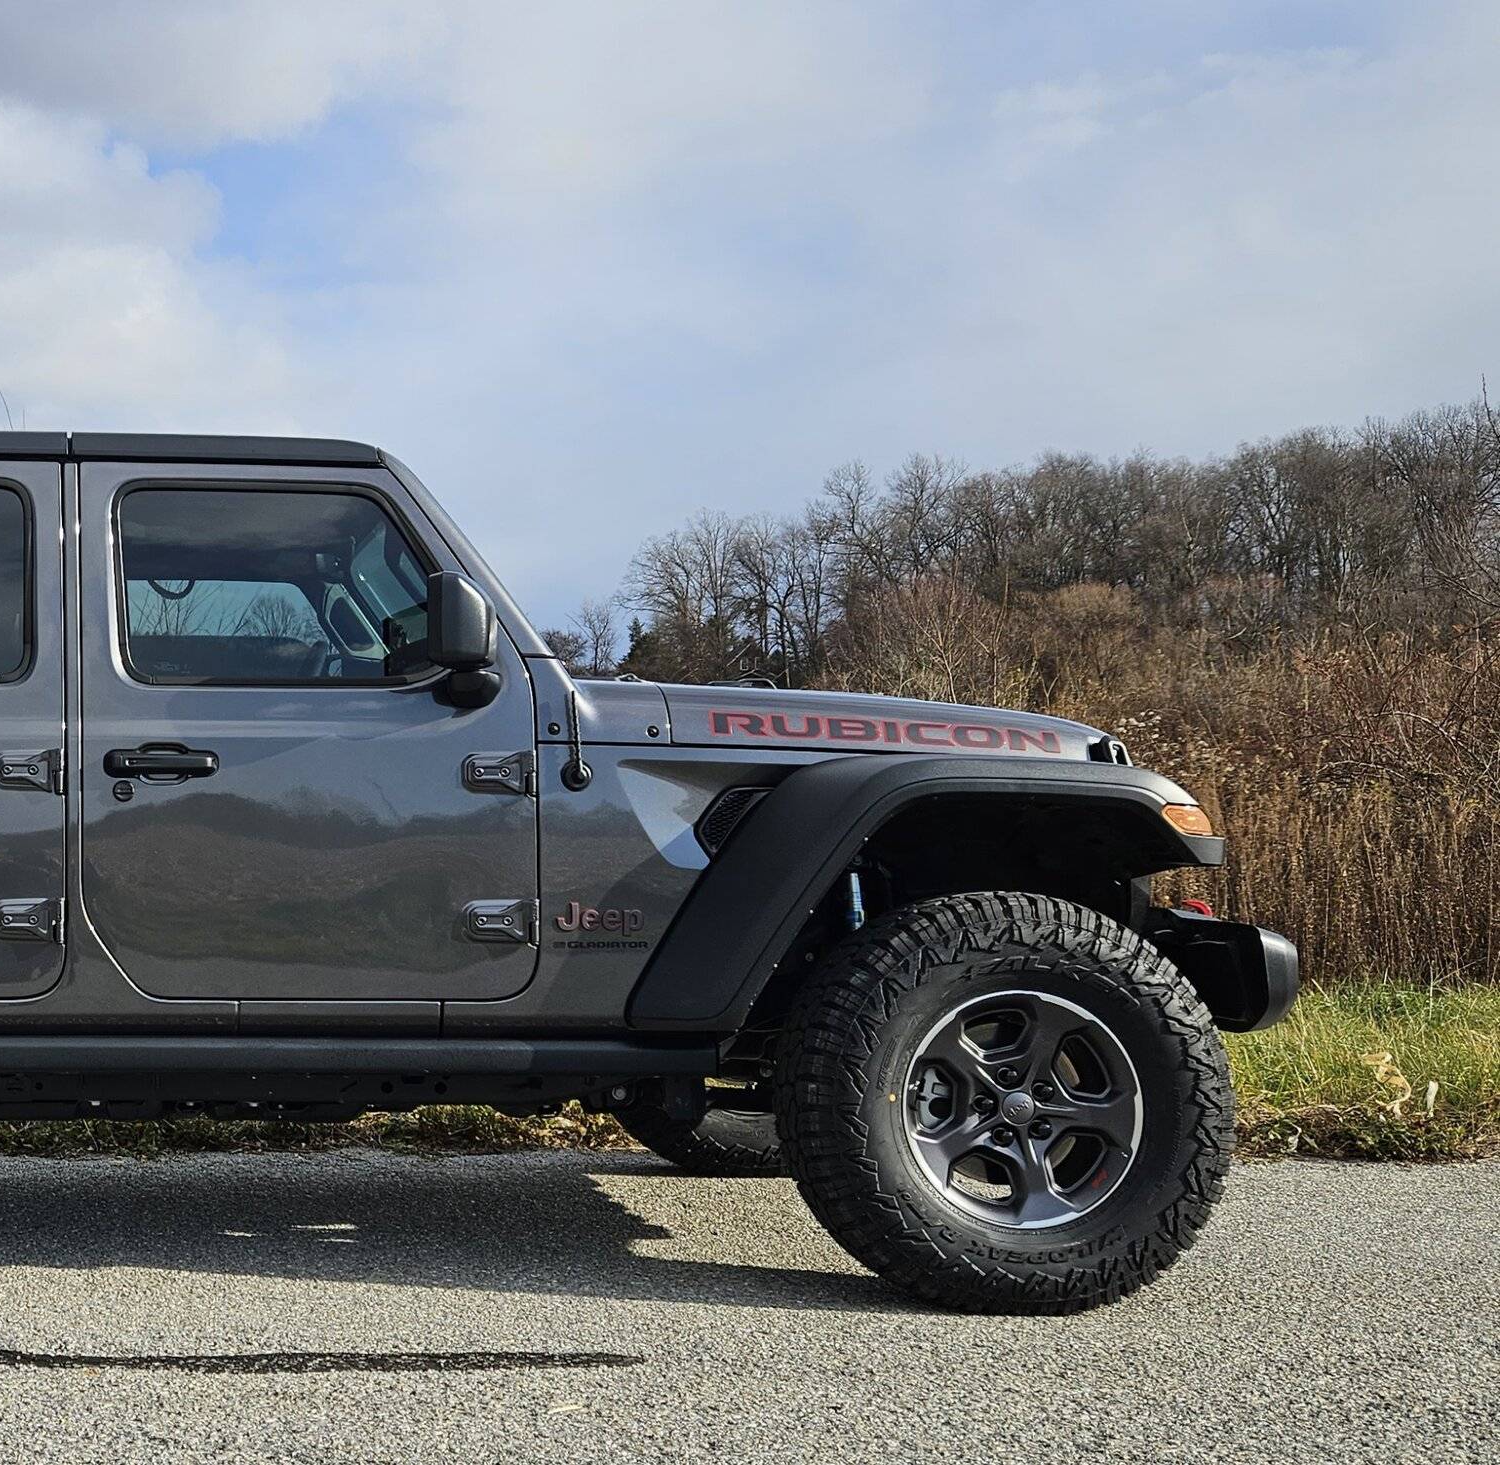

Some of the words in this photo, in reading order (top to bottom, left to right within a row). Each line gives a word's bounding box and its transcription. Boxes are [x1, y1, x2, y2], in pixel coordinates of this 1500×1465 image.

[708, 709, 1063, 754] RUBICON
[554, 900, 645, 938] Jeep
[567, 941, 649, 949] GLADIATOR
